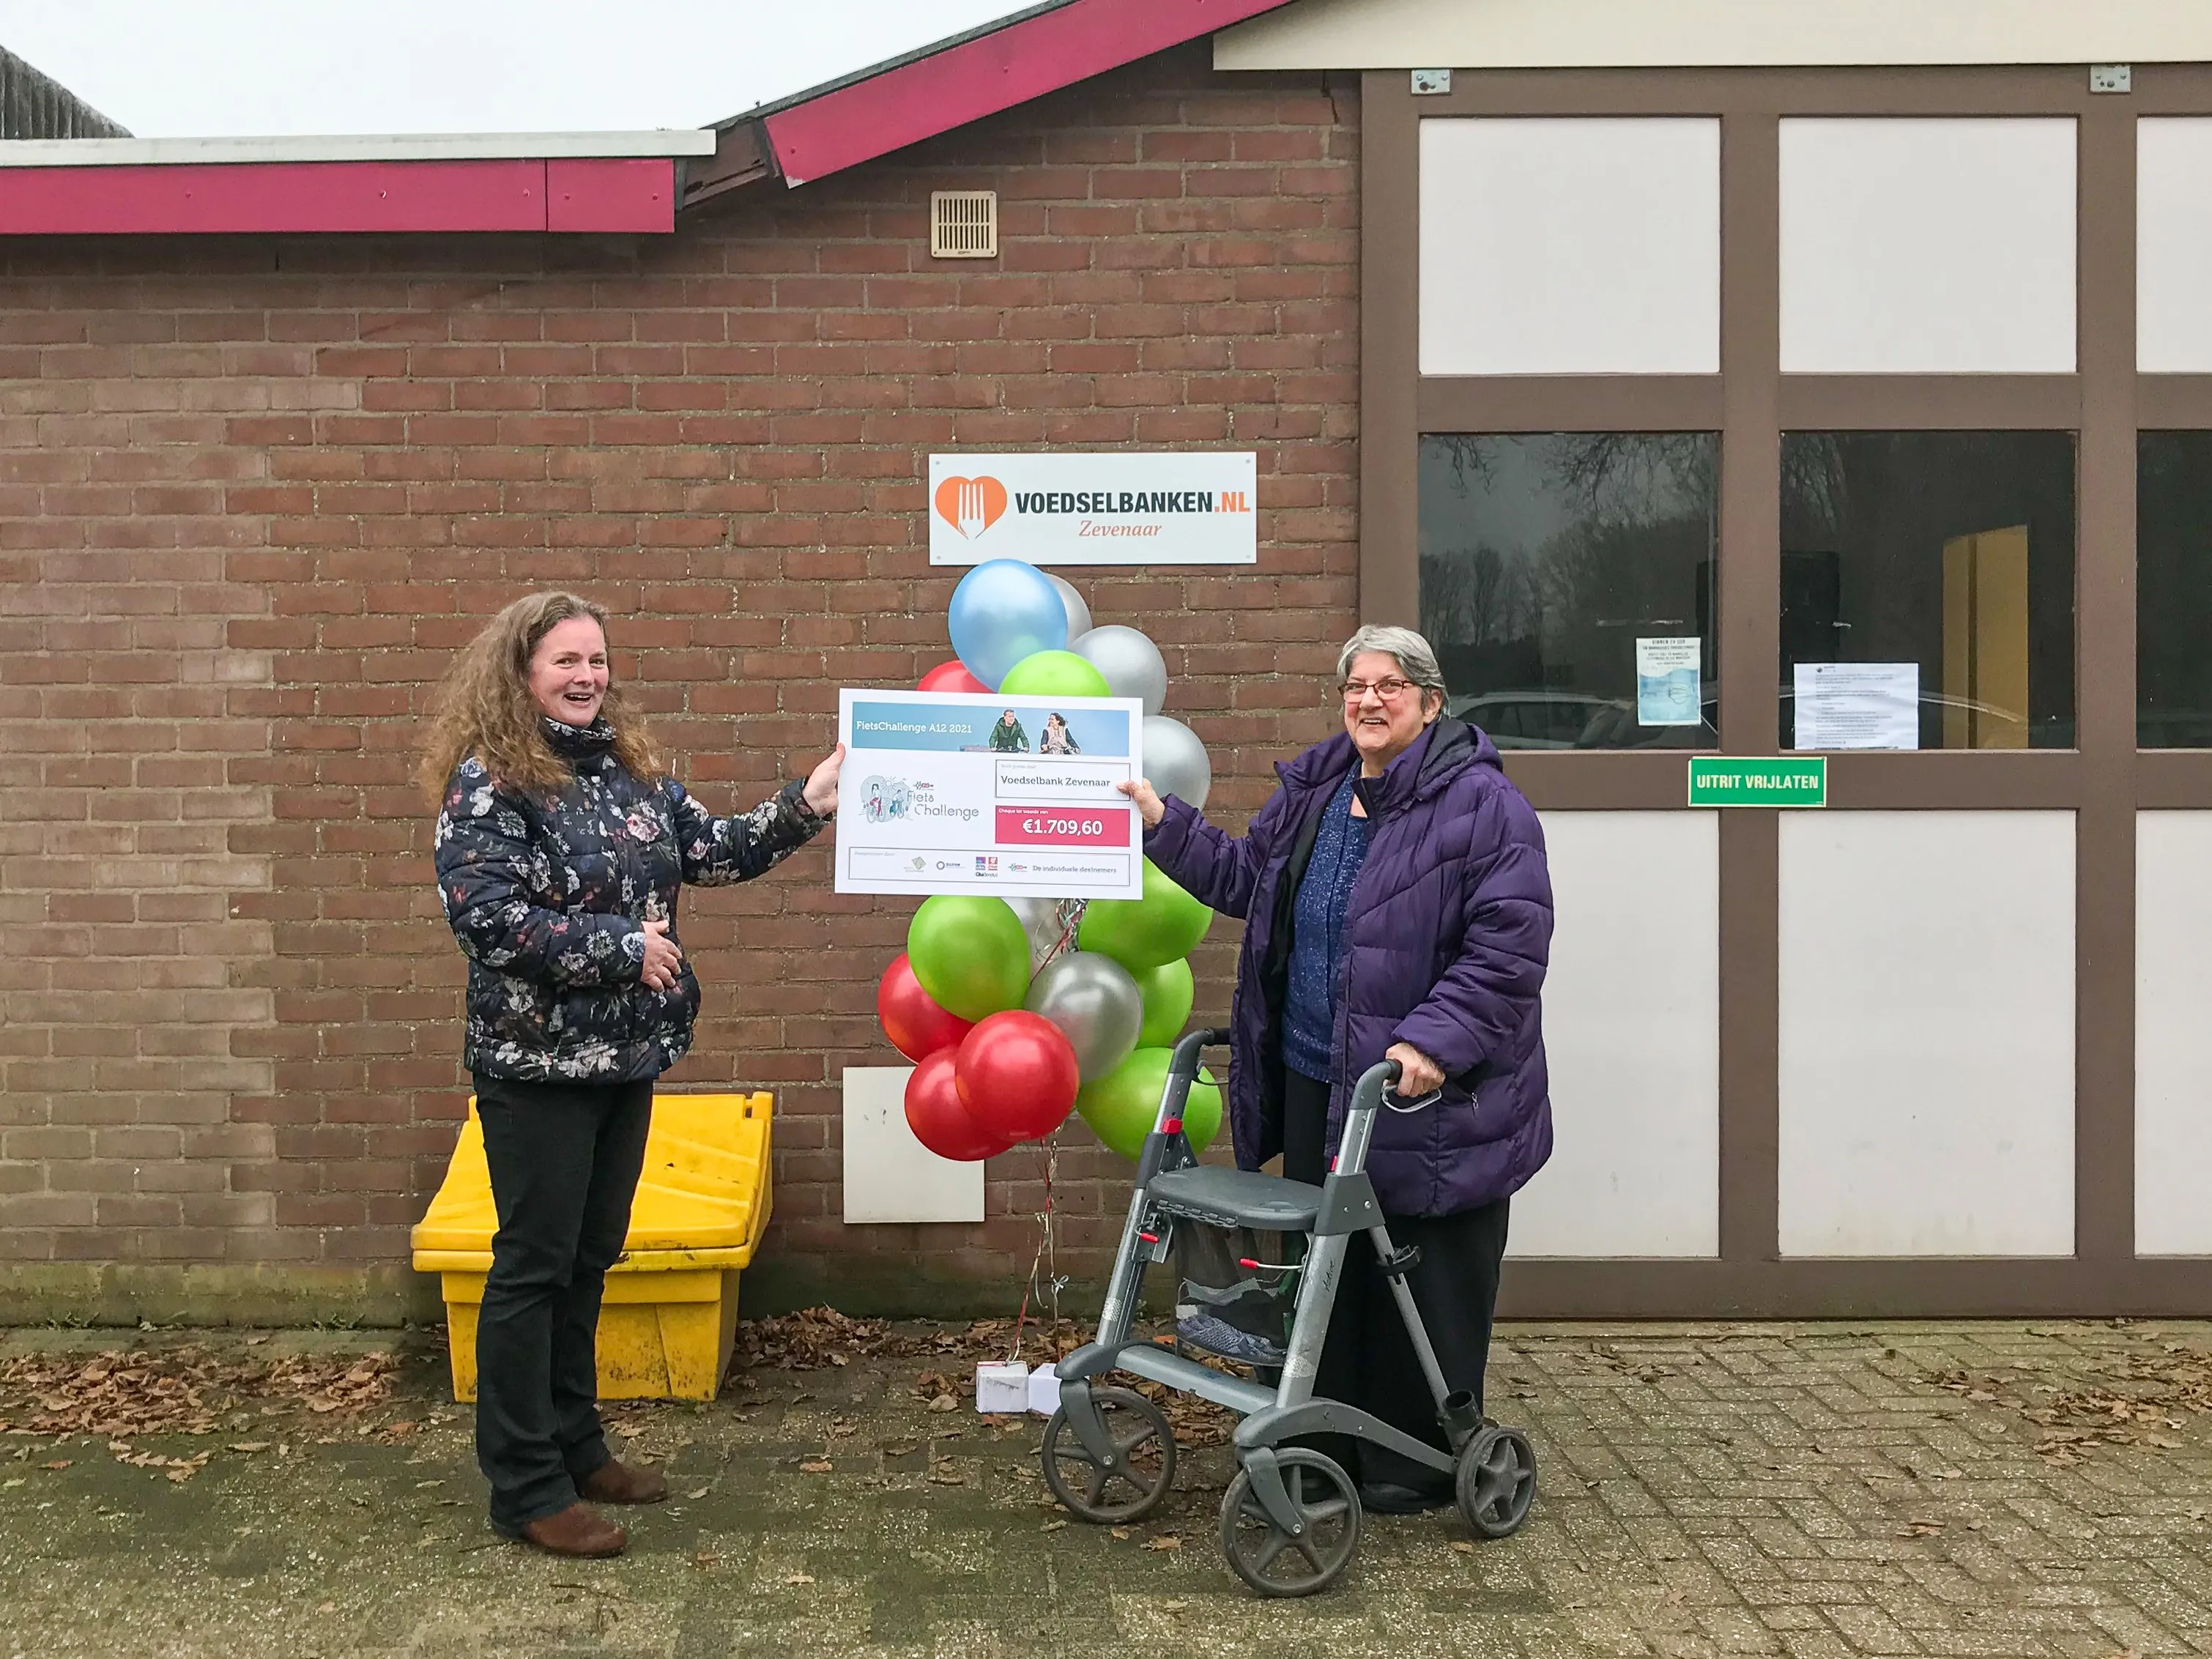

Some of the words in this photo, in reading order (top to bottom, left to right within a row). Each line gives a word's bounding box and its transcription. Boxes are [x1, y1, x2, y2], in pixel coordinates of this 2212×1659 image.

[1015, 491, 1250, 513] VOEDSELBANKEN.NL
[1078, 520, 1162, 537] Zevenaar
[856, 721, 926, 734] FietsChallenge
[929, 723, 947, 732] A12
[949, 724, 973, 733] 2021
[1001, 775, 1063, 785] Voedselbank
[1065, 777, 1110, 787] Zevenaar
[1696, 775, 1742, 788] UITRIT
[1745, 775, 1819, 789] VRIJLATEN
[908, 790, 934, 802] Fiets
[914, 804, 979, 821] Challenge
[1023, 818, 1103, 836] €1.709,60
